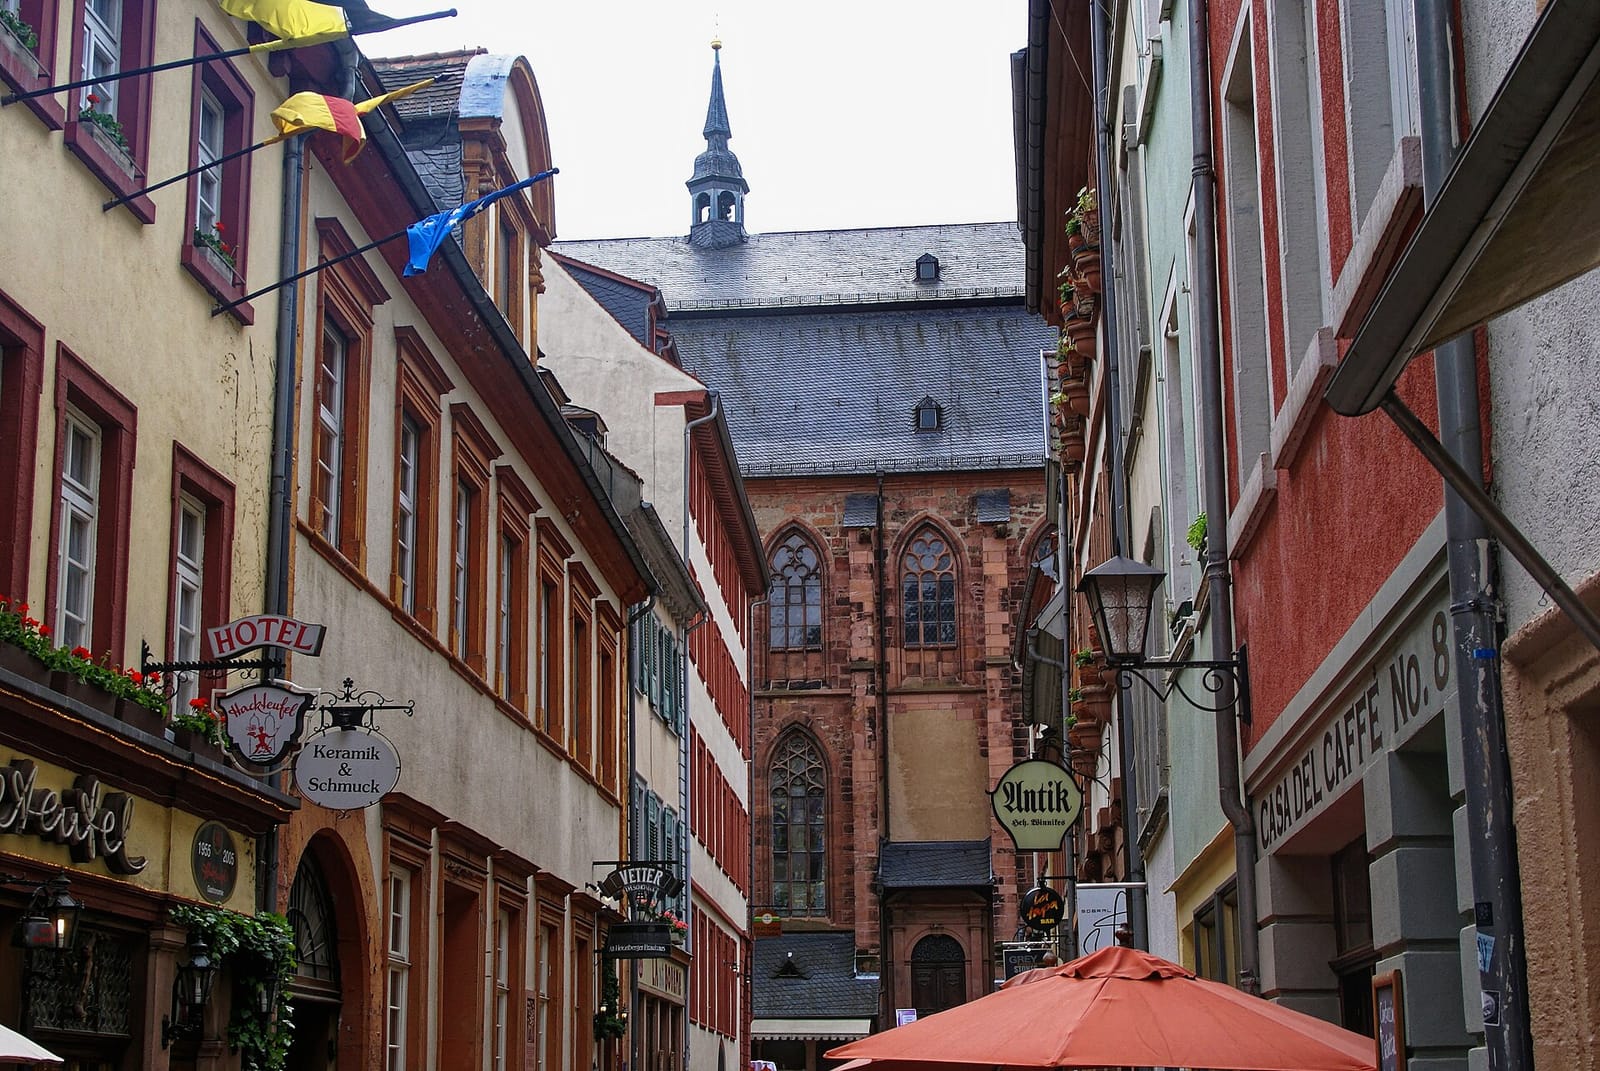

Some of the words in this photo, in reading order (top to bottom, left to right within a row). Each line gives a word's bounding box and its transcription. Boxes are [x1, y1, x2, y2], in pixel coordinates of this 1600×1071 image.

[213, 617, 313, 654] HOTEL
[228, 692, 299, 719] Hackteufel
[1260, 777, 1293, 850] CASA
[1292, 748, 1323, 821] DEL
[1432, 610, 1450, 692] 8
[313, 744, 380, 761] Keramik
[337, 762, 352, 777] &
[307, 777, 380, 794] Schmuck
[1003, 780, 1073, 814] Antik
[222, 848, 235, 867] 2005
[618, 867, 664, 886] VETTER
[1008, 955, 1038, 964] GREY
